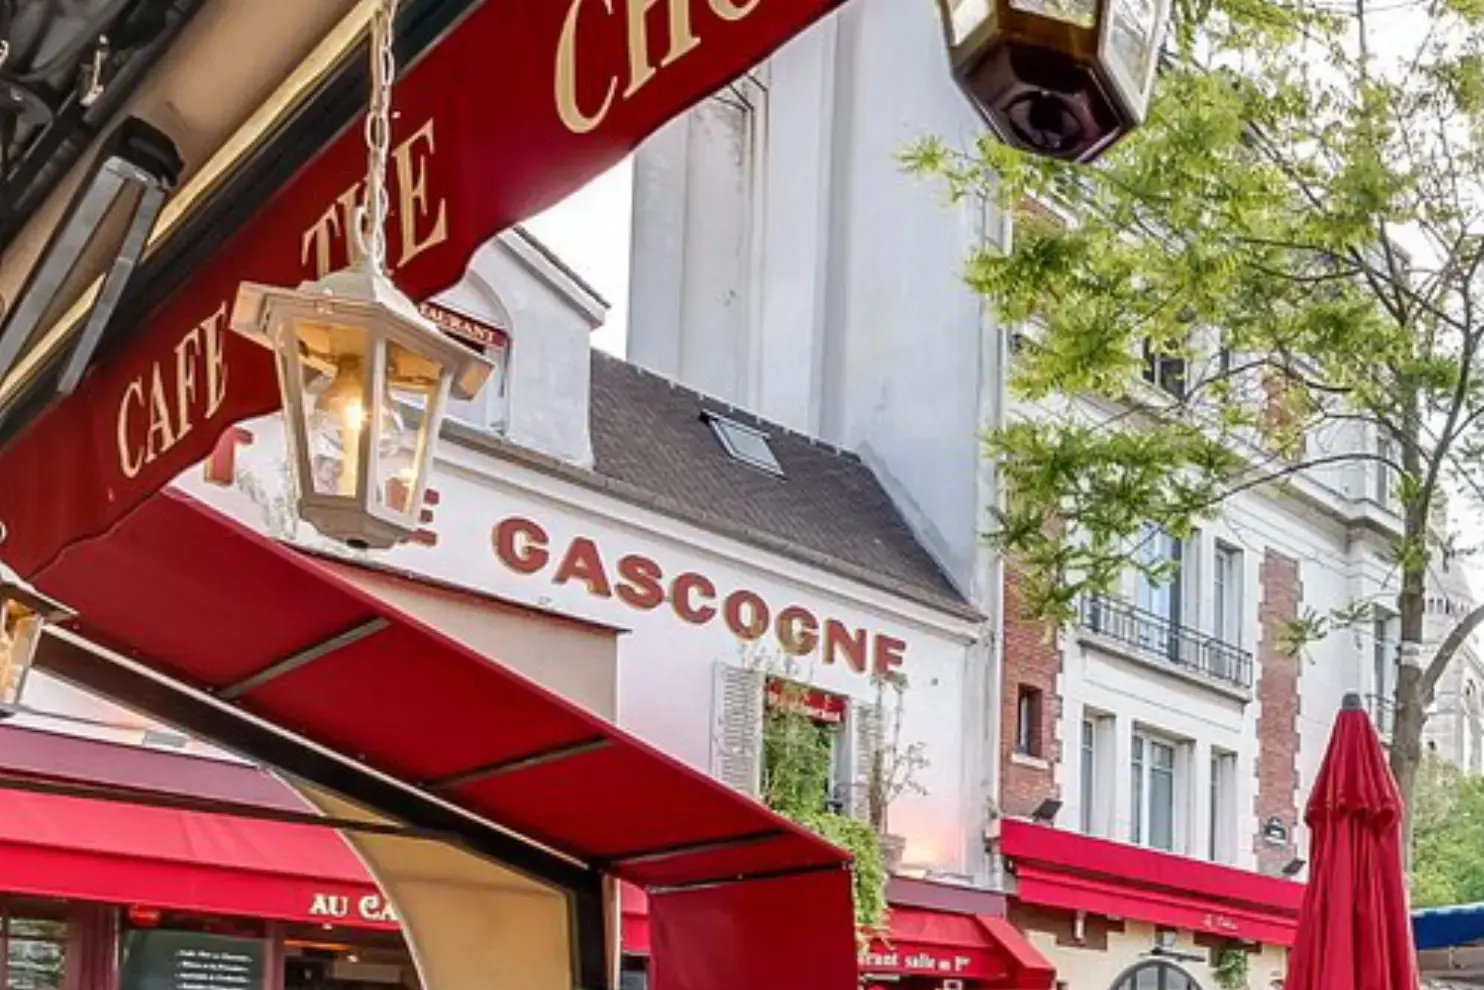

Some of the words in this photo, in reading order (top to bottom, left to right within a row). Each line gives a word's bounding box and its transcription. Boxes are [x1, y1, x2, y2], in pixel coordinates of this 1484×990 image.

[117, 302, 229, 478] CAFE
[554, 0, 761, 133] CH
[491, 517, 907, 677] GASCOGNE
[309, 893, 348, 917] AU
